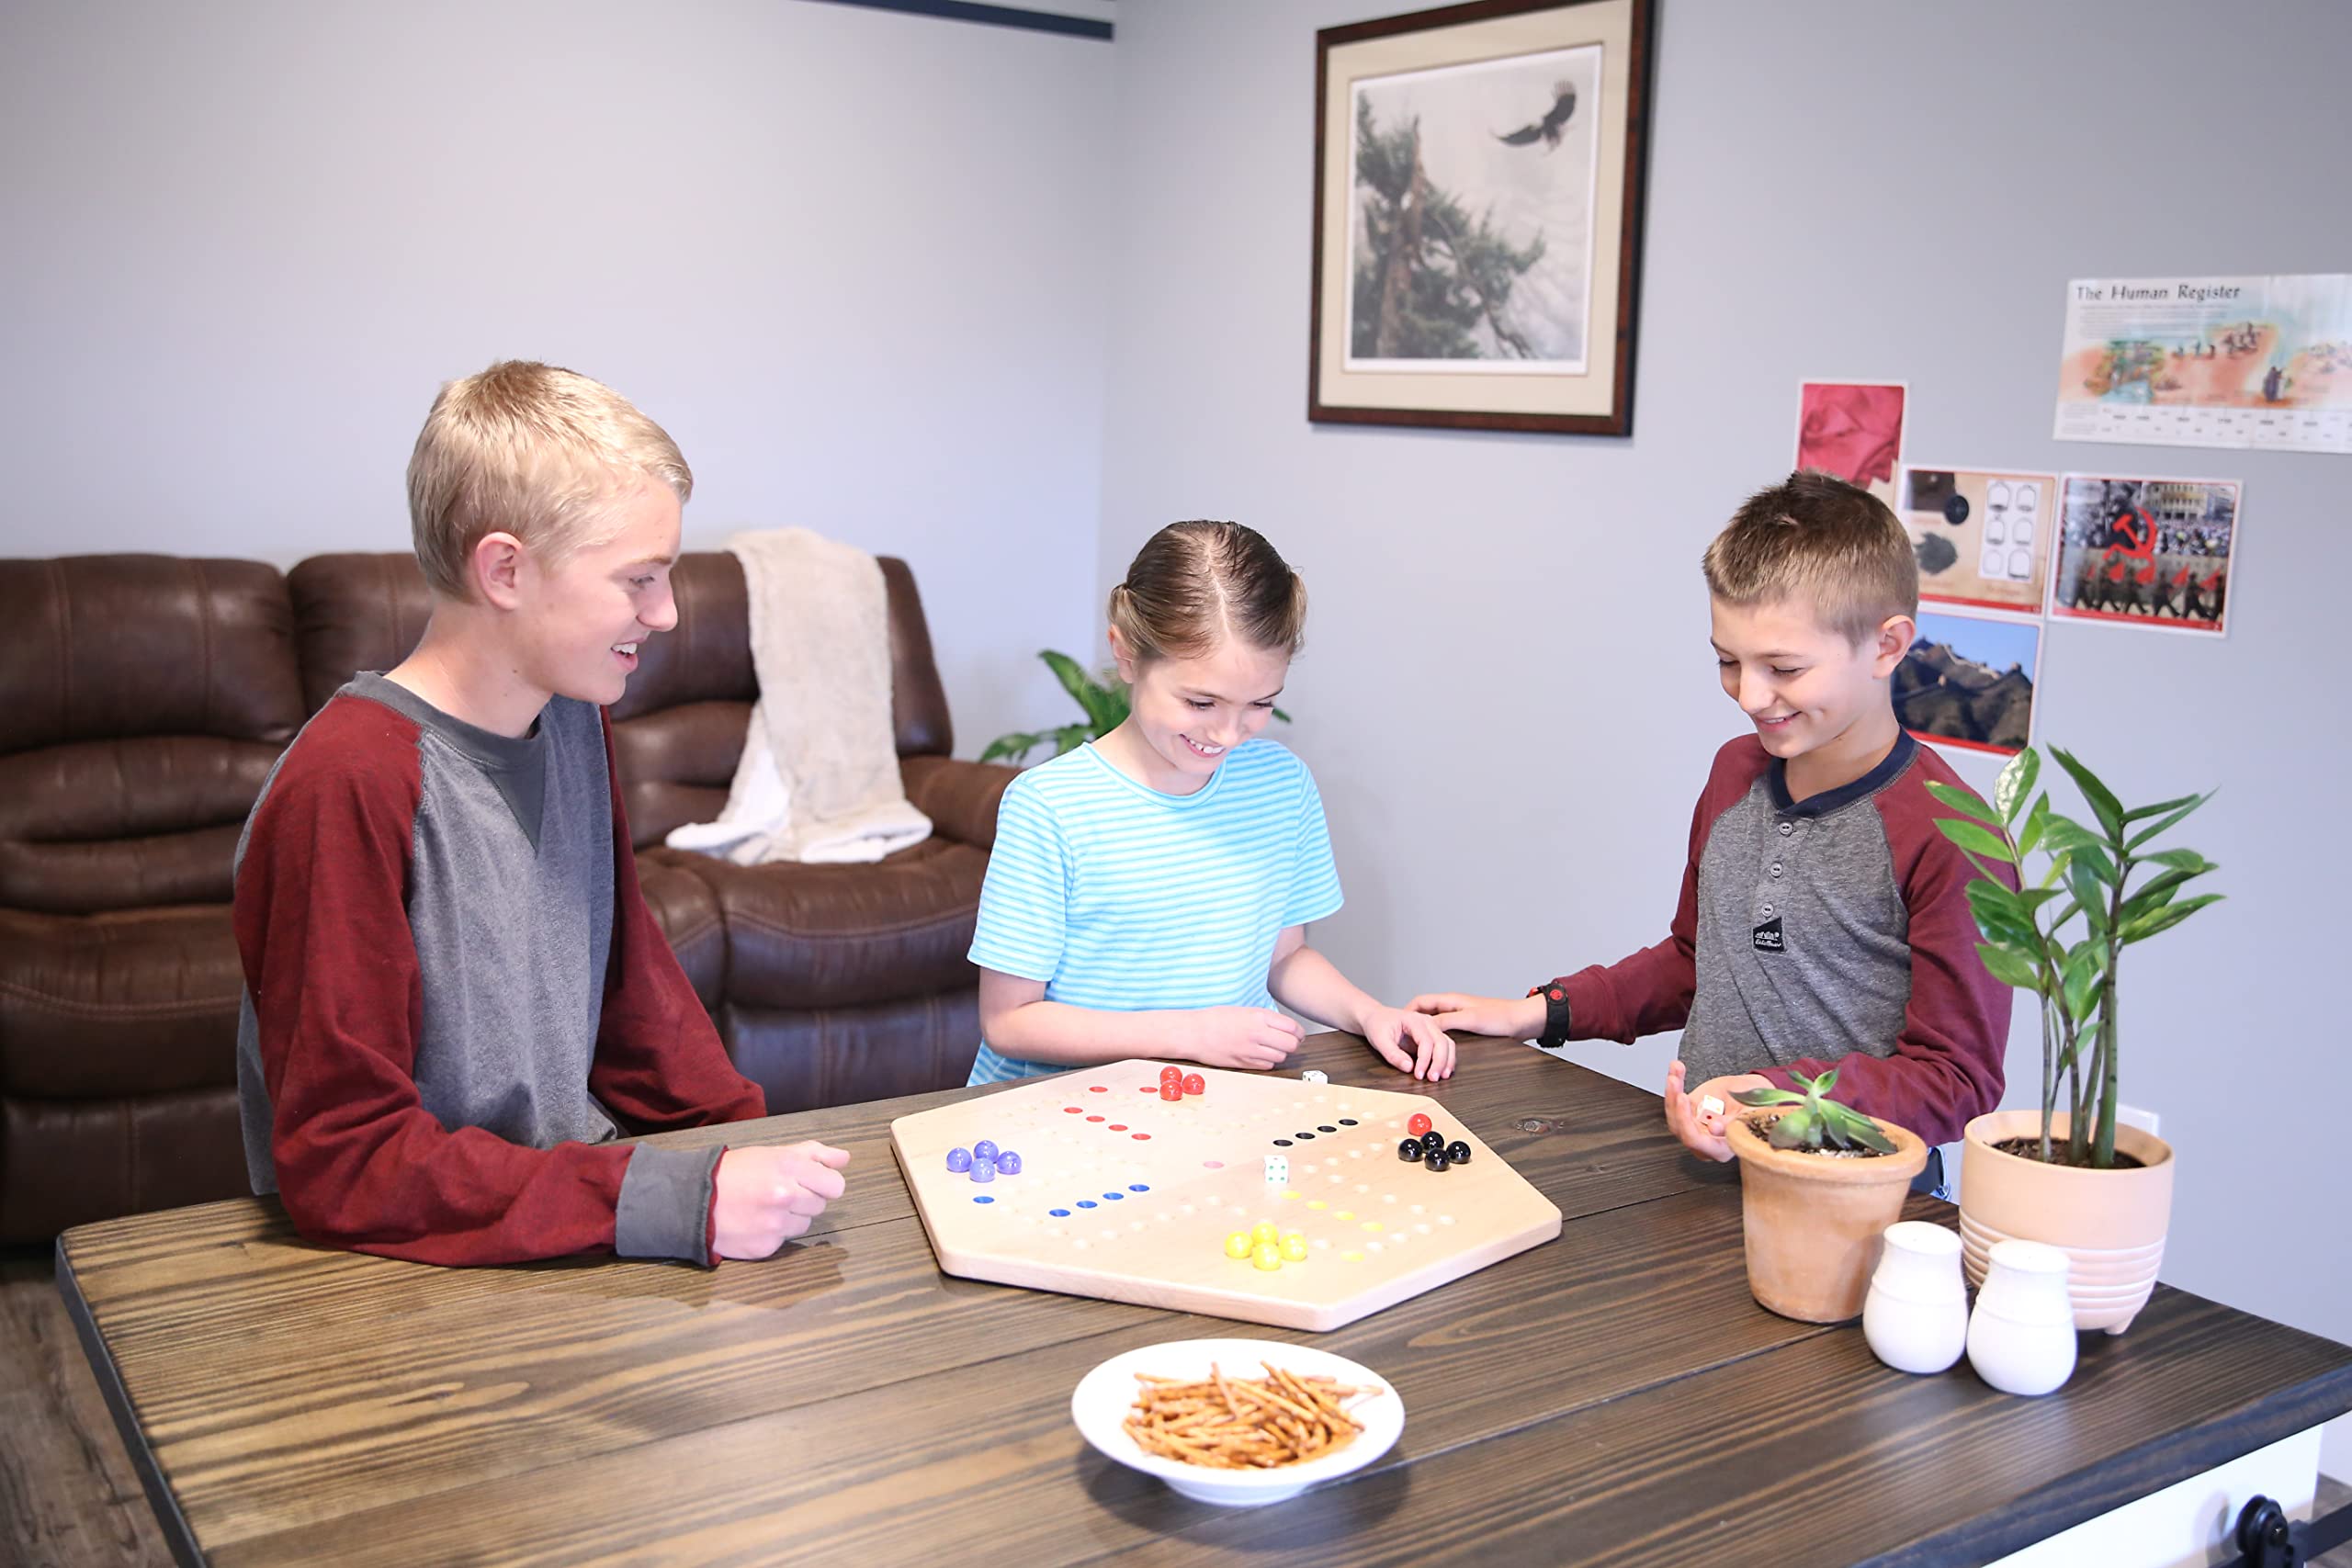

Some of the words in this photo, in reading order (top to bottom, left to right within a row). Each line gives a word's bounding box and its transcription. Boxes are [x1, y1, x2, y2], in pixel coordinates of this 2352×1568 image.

[2077, 286, 2103, 299] The
[2111, 285, 2169, 299] Human
[2177, 283, 2240, 303] Register
